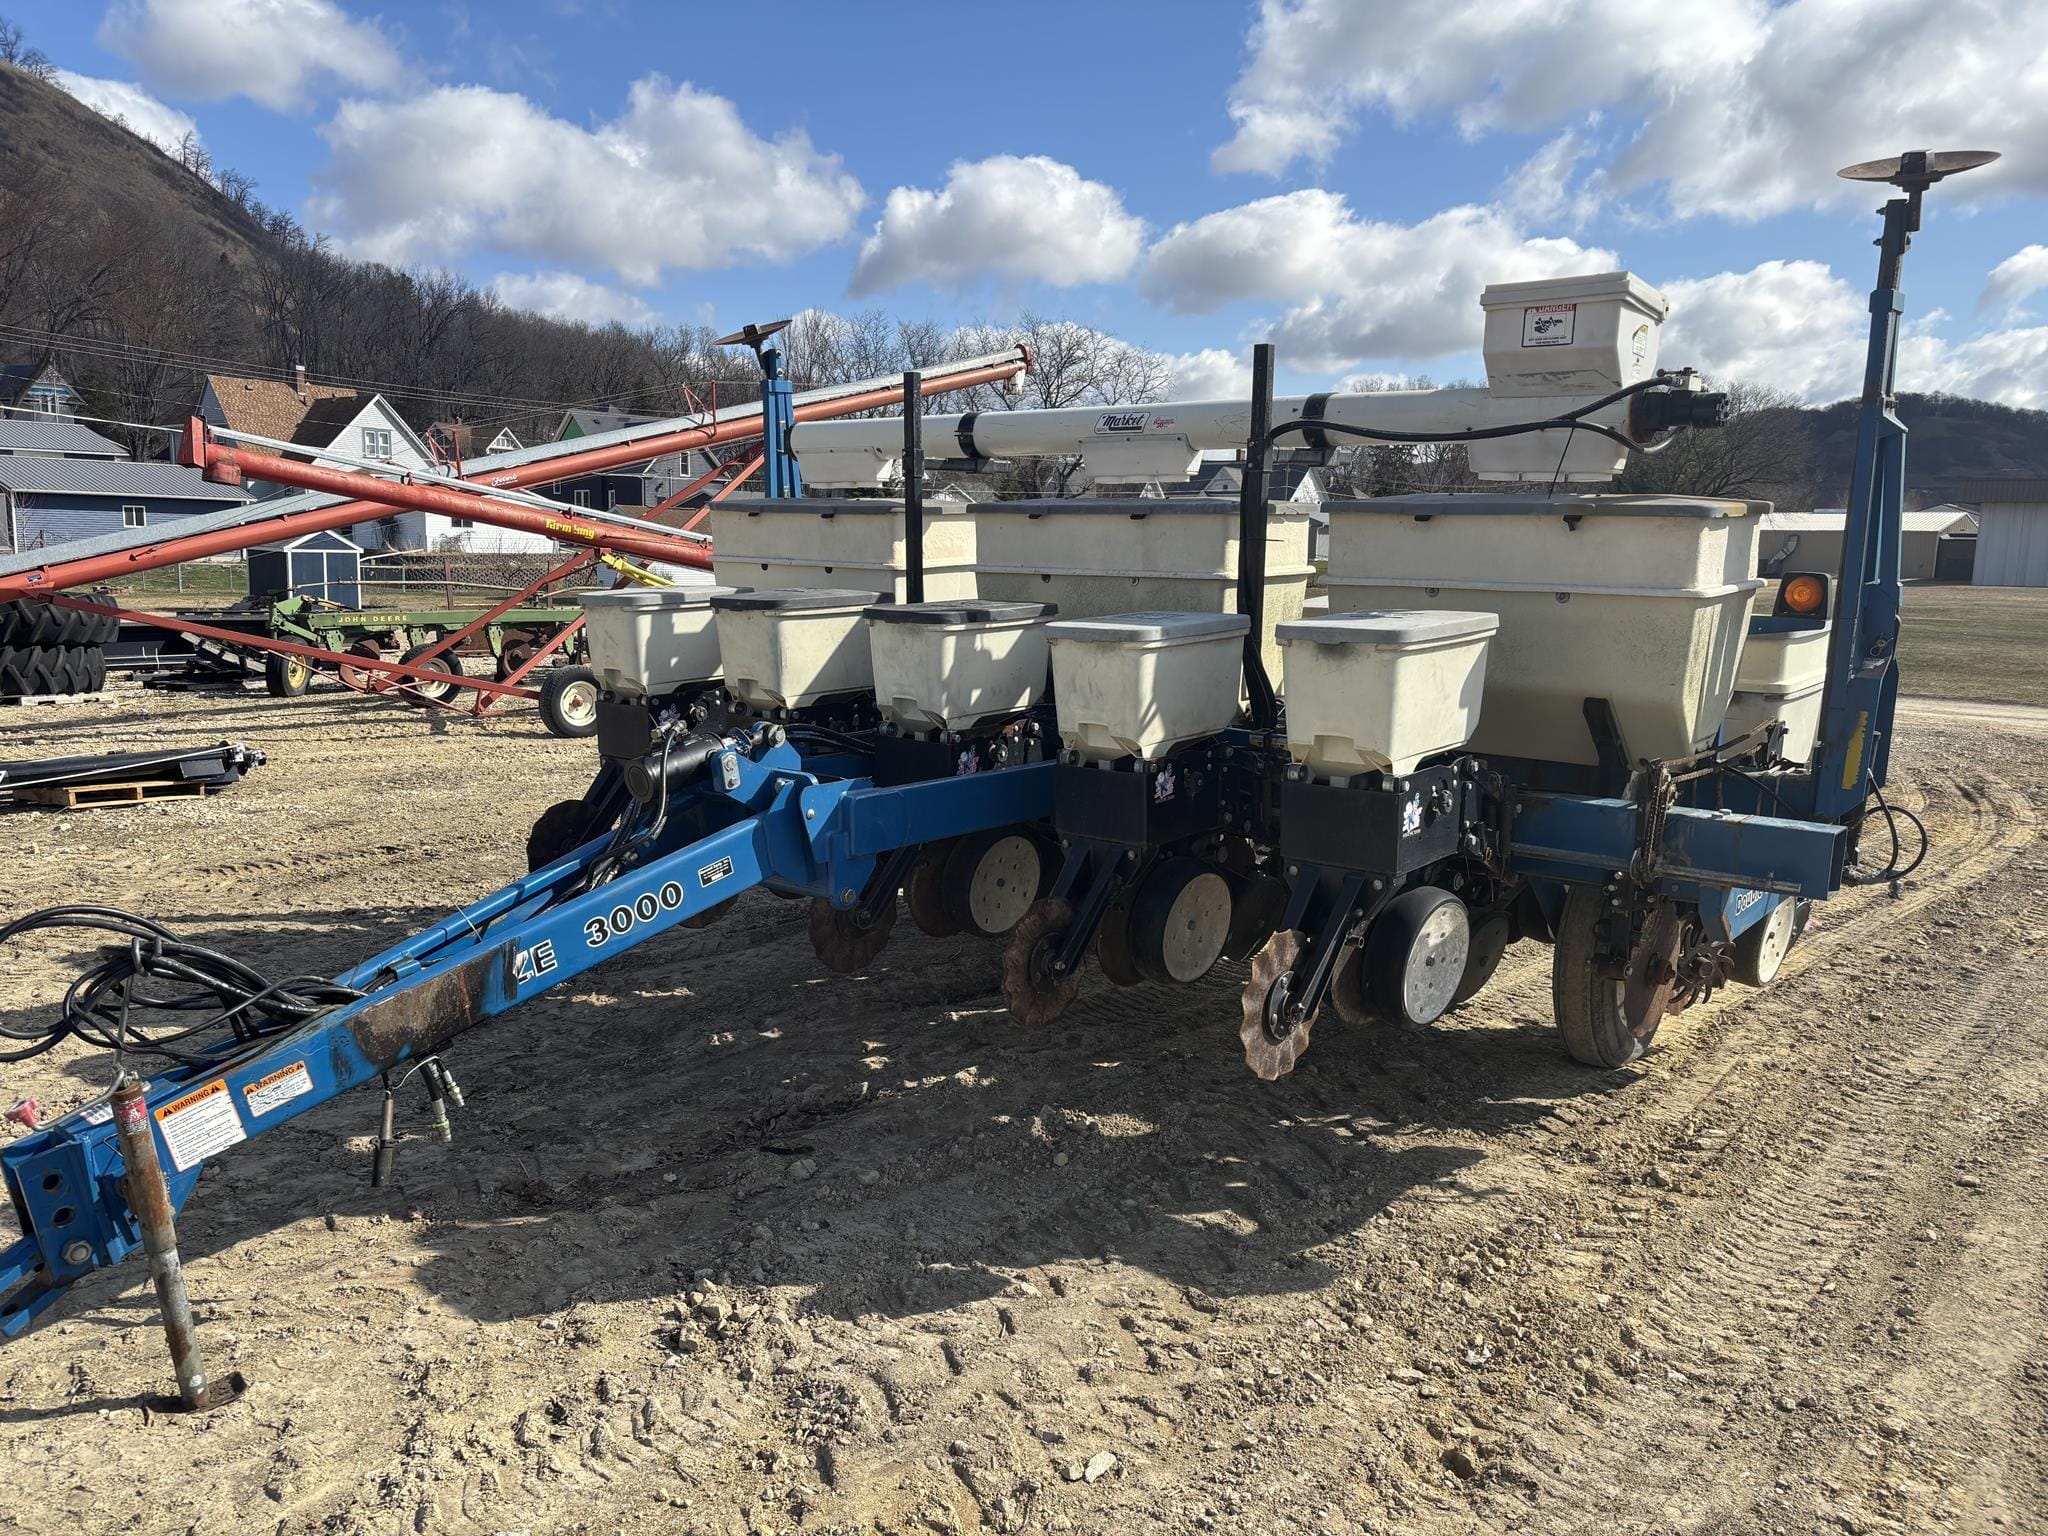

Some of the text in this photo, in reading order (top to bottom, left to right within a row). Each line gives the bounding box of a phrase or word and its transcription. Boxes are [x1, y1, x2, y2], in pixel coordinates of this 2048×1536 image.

[1538, 303, 1573, 313] DANGER
[1102, 413, 1145, 427] Market
[545, 518, 572, 532] Farm
[372, 614, 408, 622] DEERE
[583, 880, 685, 948] 3000
[254, 1065, 295, 1090] WARNING
[171, 1089, 210, 1112] WARNING
